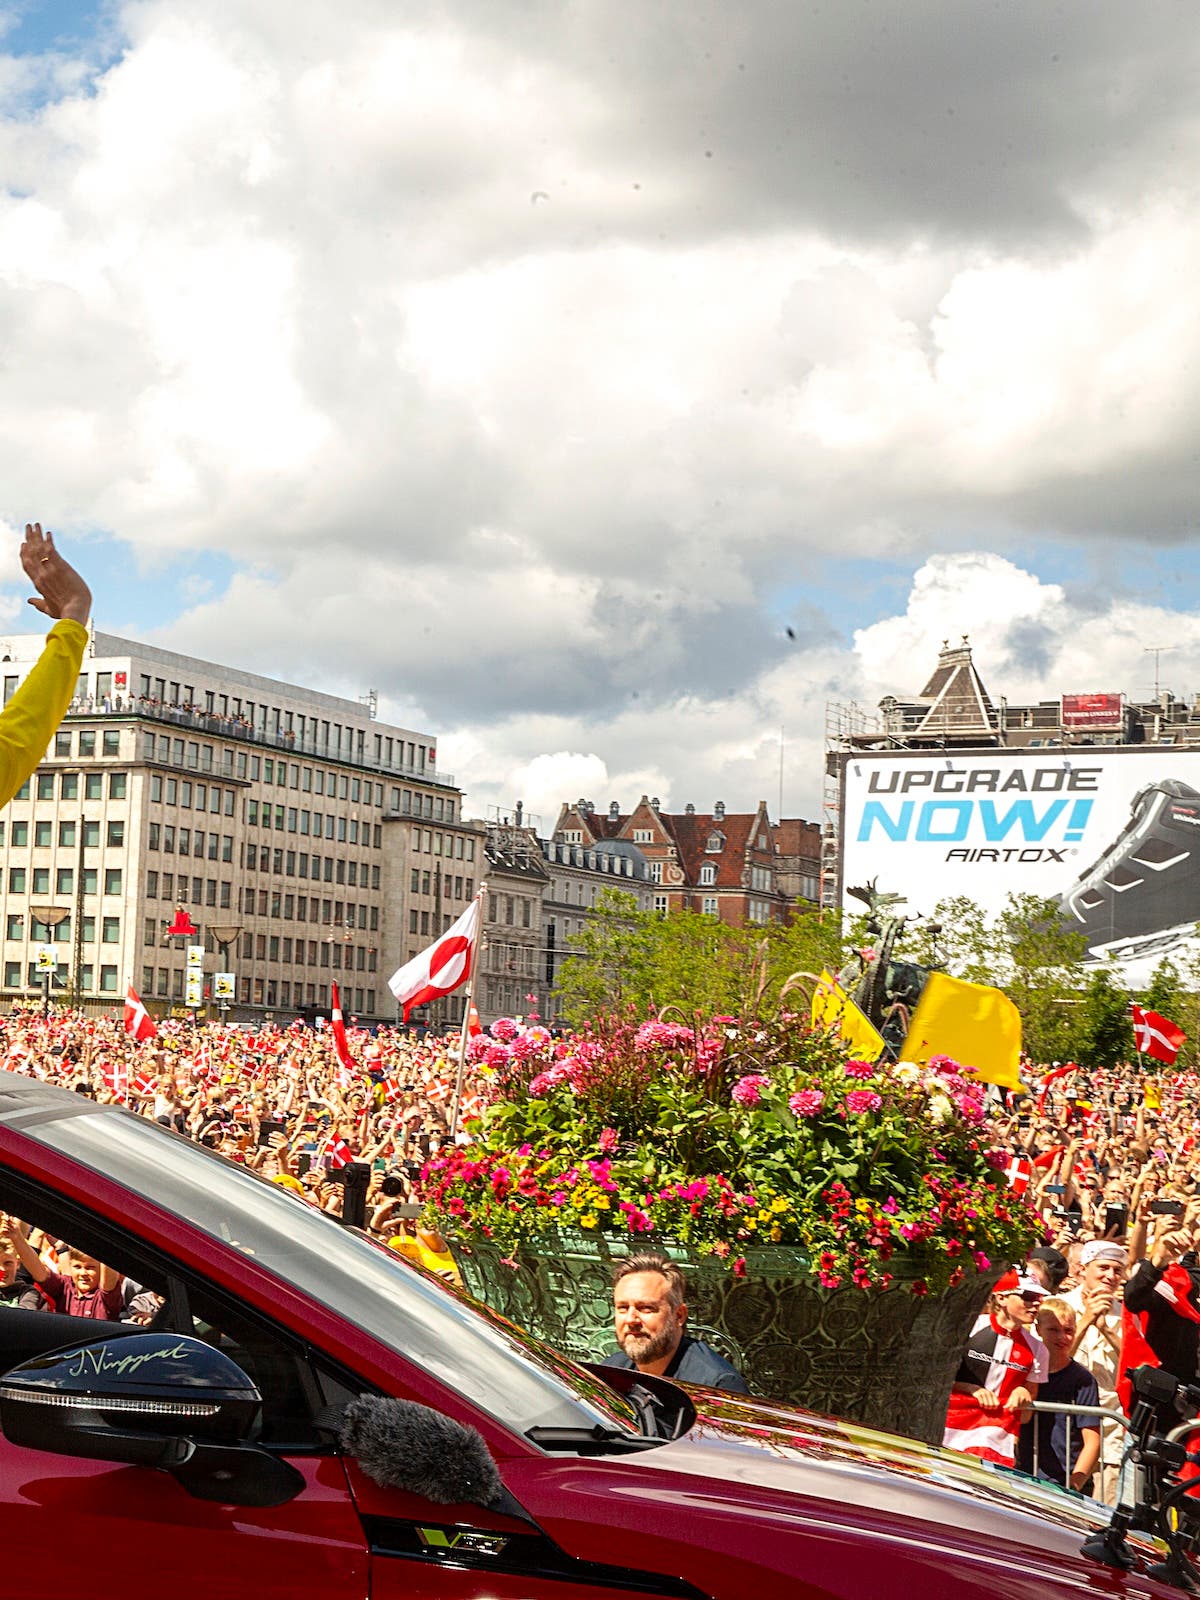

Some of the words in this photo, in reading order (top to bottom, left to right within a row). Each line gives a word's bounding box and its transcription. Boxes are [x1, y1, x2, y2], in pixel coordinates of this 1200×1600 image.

[868, 768, 1103, 793] UPGRADE
[856, 799, 1095, 841] NOW!
[945, 848, 1069, 863] AIRTOX
